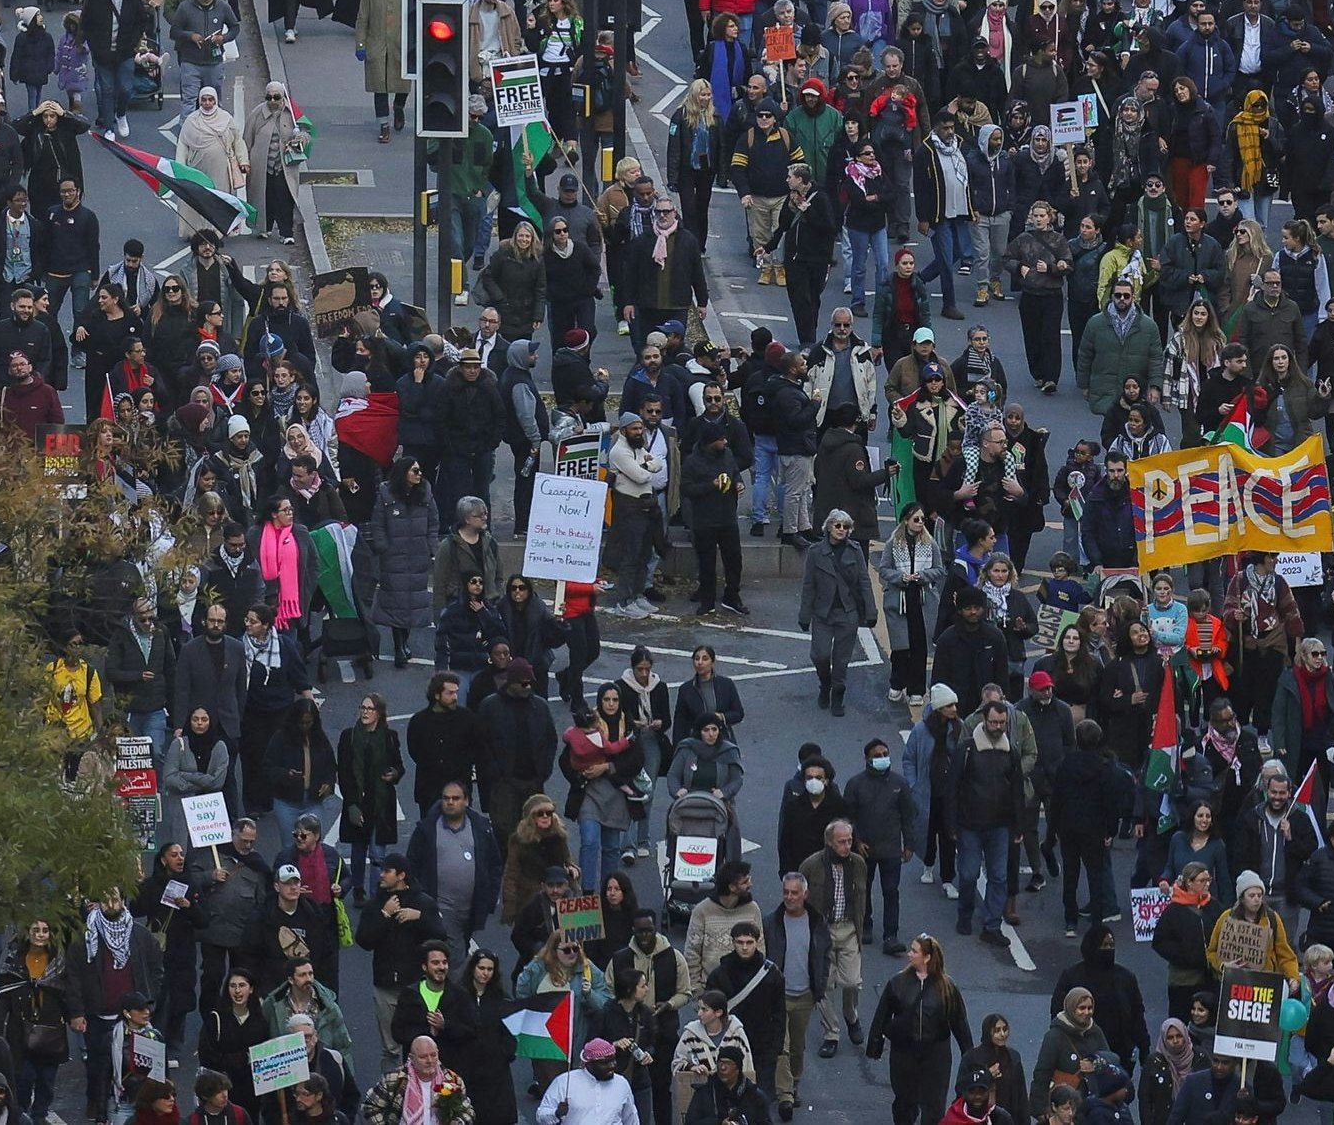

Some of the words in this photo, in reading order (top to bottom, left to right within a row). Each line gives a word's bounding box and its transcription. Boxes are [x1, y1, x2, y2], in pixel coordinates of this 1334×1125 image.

[495, 83, 542, 105] FREE
[497, 101, 542, 113] PALESTINE
[1054, 126, 1083, 134] PALESTINE
[316, 307, 355, 325] FREEDOM
[557, 457, 599, 476] FREE
[540, 479, 588, 502] Ceasefire
[558, 500, 591, 518] Now!
[1144, 452, 1316, 555] PEACE
[534, 524, 551, 536] Stop
[555, 527, 567, 536] the
[531, 538, 547, 549] Stop
[552, 540, 564, 549] the
[1276, 556, 1307, 565] NAKBA
[1282, 567, 1303, 575] 2023
[119, 745, 150, 757] FREEDOM
[117, 759, 153, 771] PALESTINE
[190, 800, 220, 812] Jews
[196, 810, 216, 822] say
[192, 821, 227, 833] ceasefire
[200, 831, 225, 843] now
[687, 845, 707, 853] FREE
[559, 896, 599, 914] CEASE
[564, 924, 603, 943] NOW!
[1221, 931, 1229, 940] IS
[1232, 933, 1237, 942] A
[1238, 936, 1262, 948] MORAL
[1247, 947, 1265, 958] TEST
[1230, 984, 1255, 1001] END
[1254, 986, 1277, 1005] THE
[1226, 999, 1274, 1024] SIEGE
